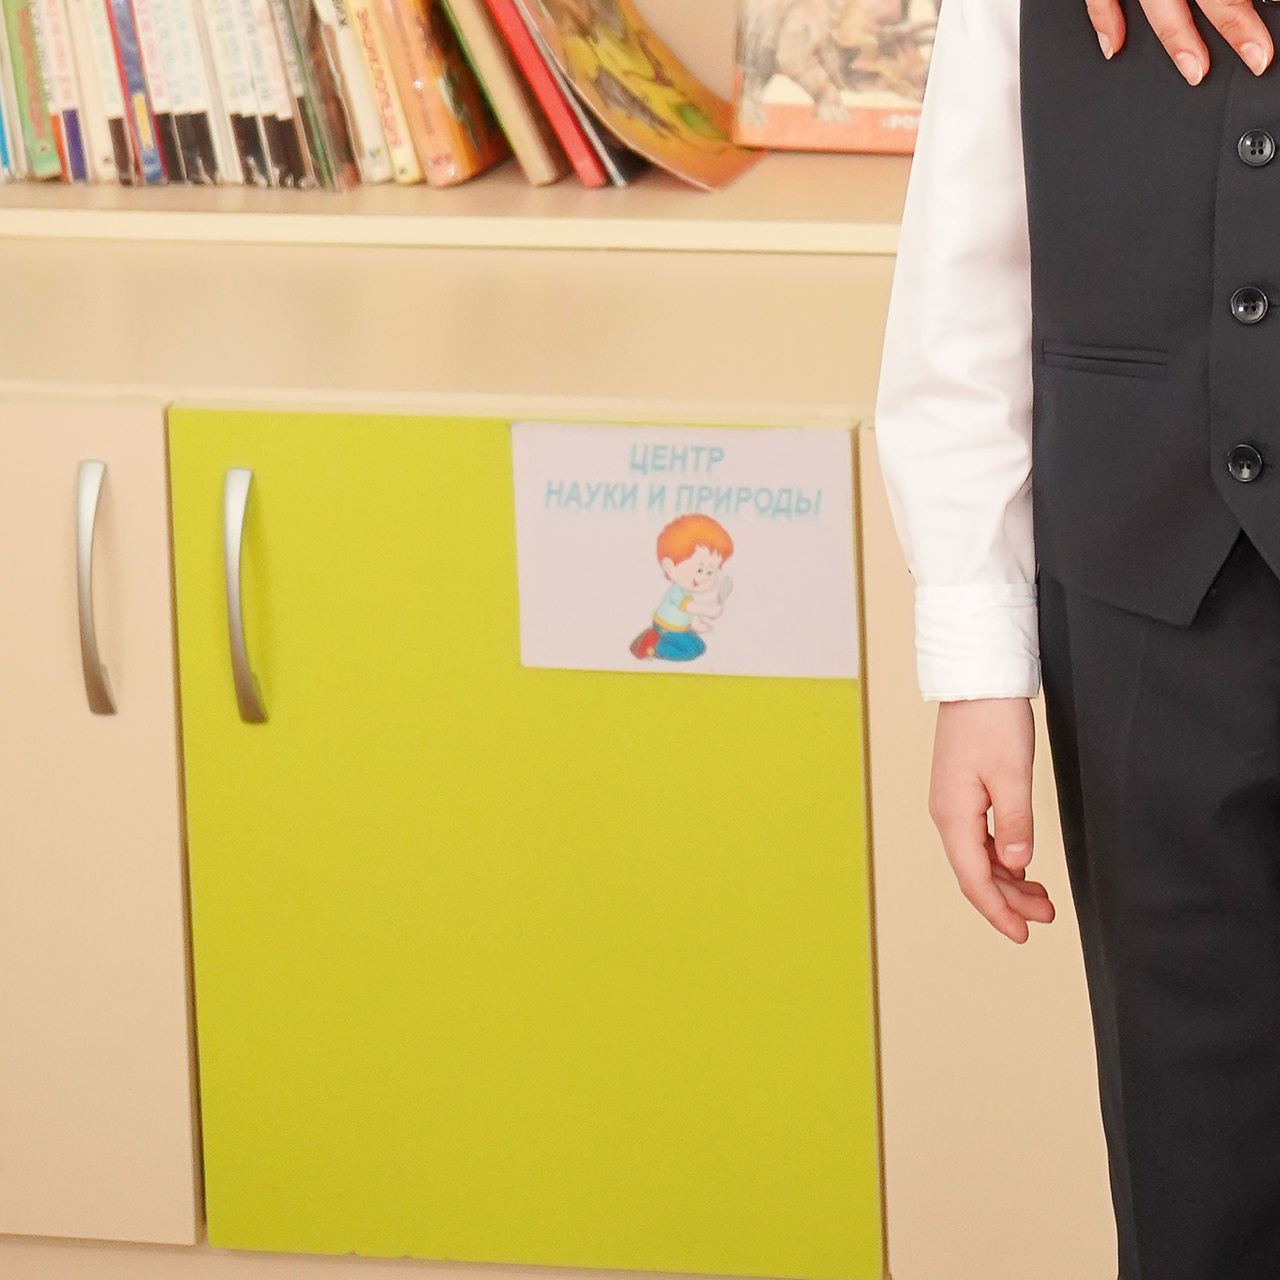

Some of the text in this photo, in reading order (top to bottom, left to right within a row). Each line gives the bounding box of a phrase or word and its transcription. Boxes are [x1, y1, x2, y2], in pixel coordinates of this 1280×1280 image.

[630, 443, 725, 475] ЦЕНТР
[544, 481, 822, 519] НАУКИ И ПРИРОДЫ
